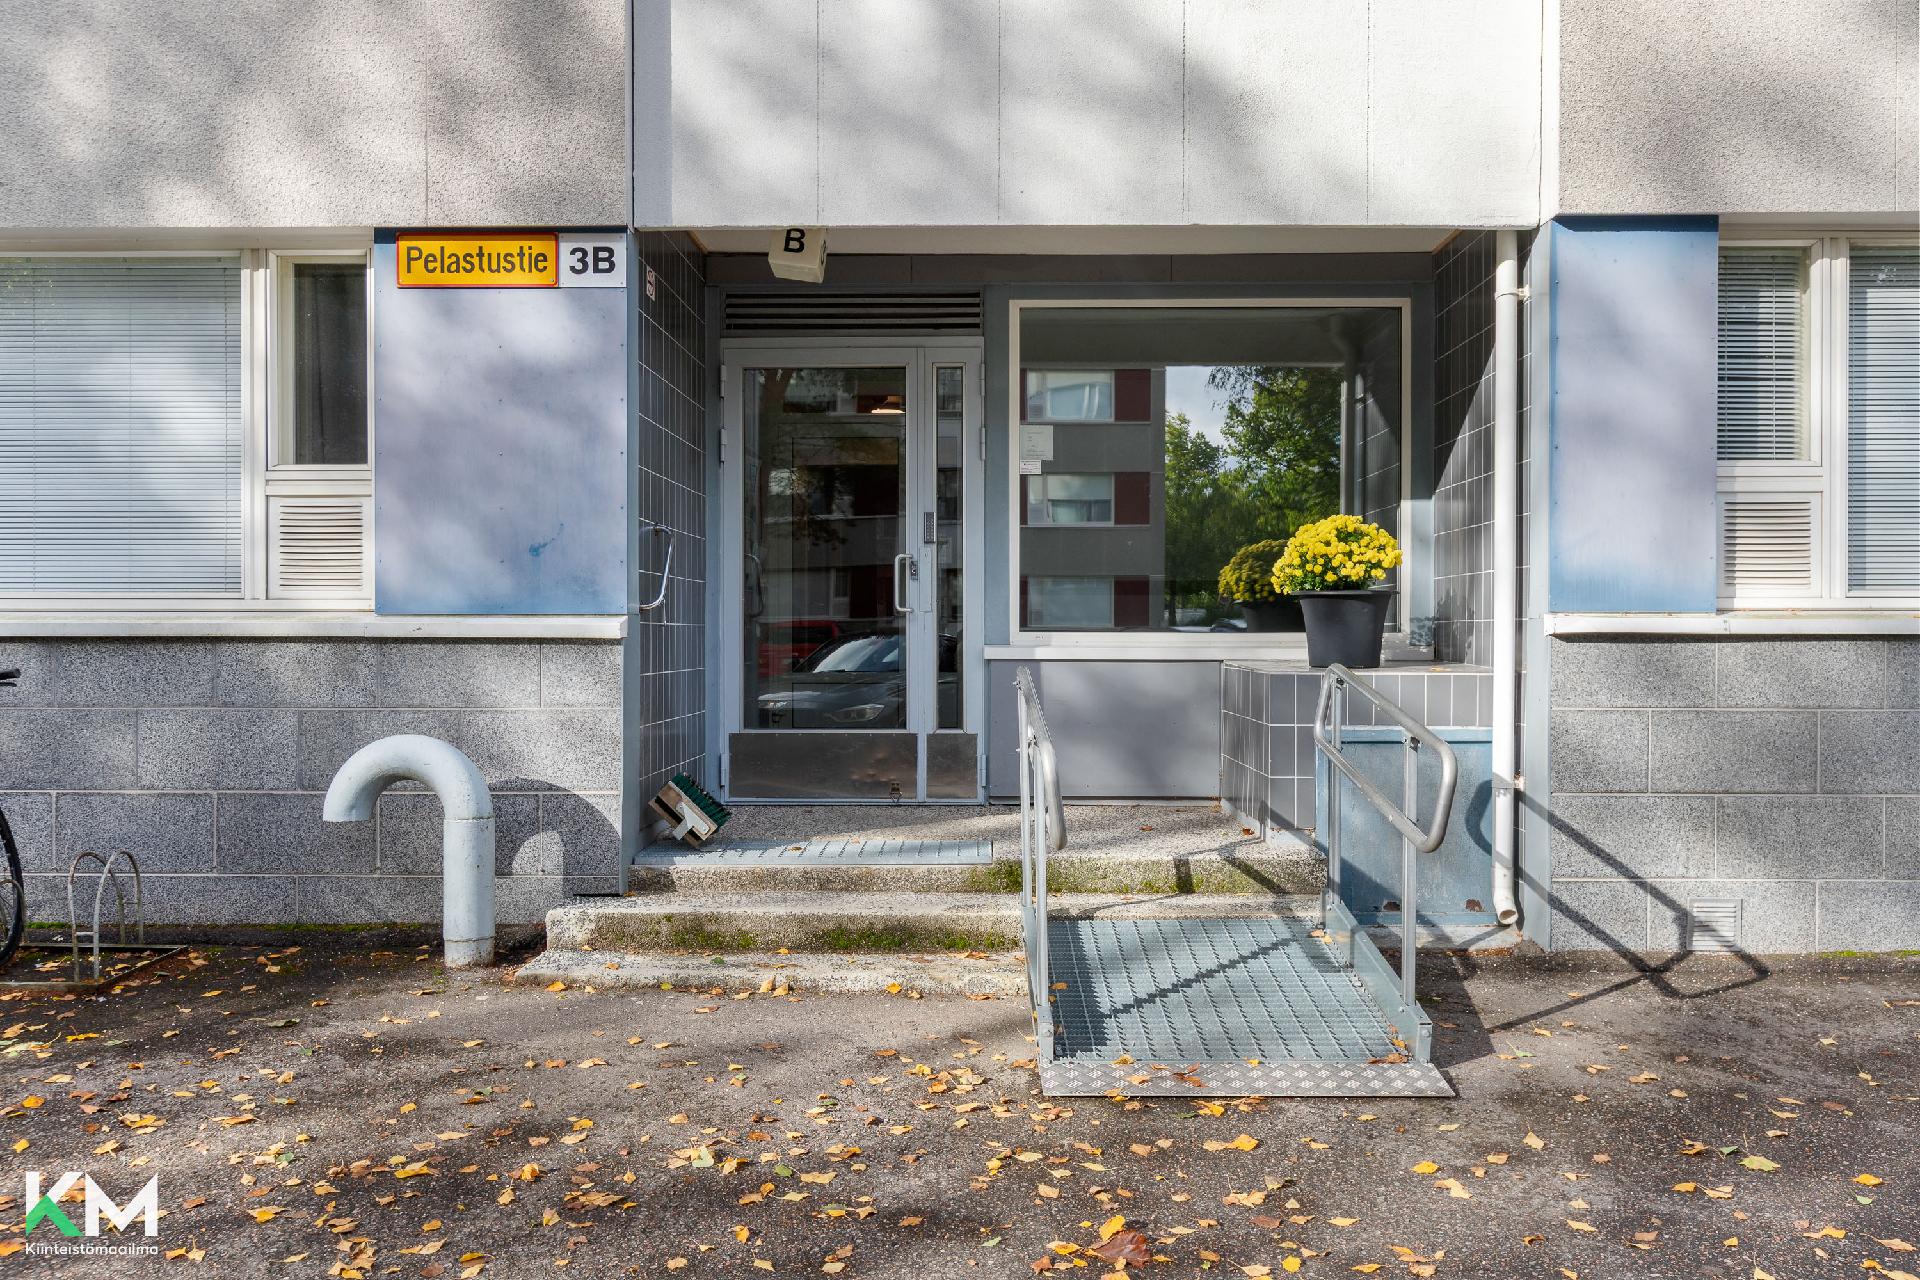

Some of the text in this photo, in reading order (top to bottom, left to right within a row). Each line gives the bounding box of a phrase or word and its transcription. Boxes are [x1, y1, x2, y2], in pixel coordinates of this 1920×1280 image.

[784, 228, 805, 253] B
[406, 246, 548, 274] Pelastustie
[569, 246, 616, 275] 3B
